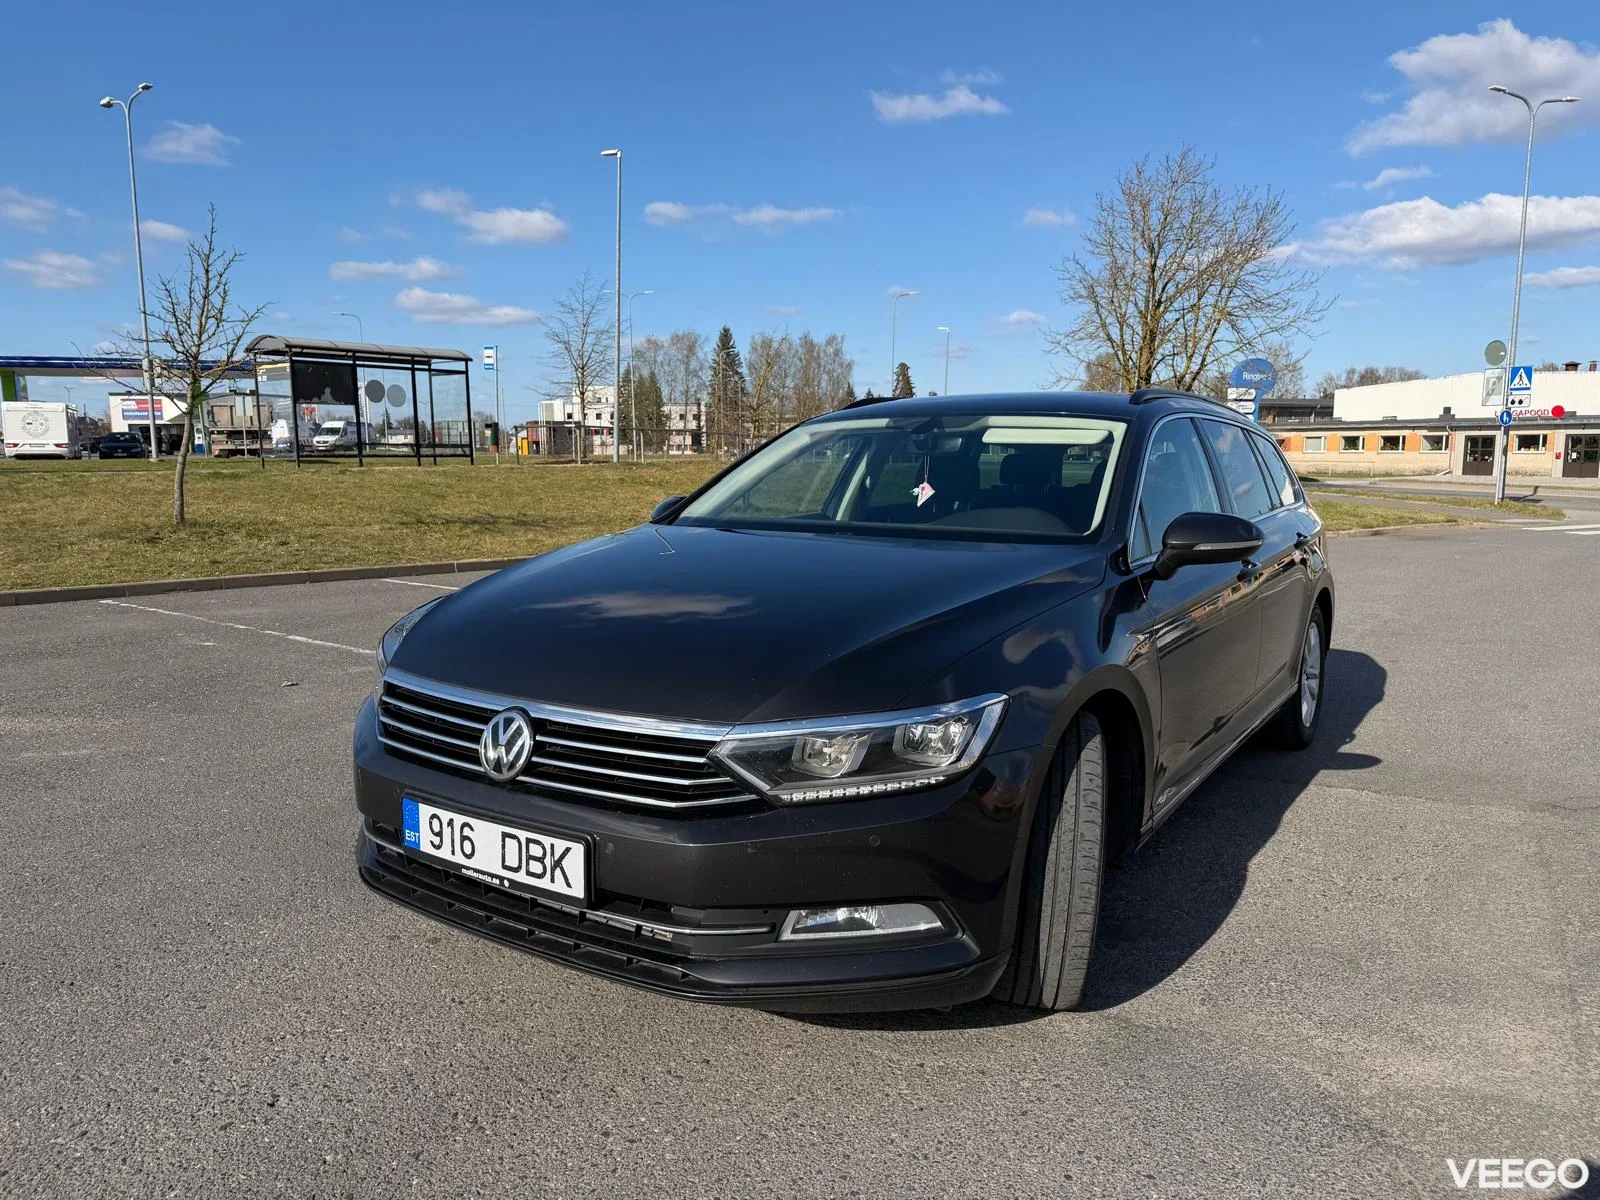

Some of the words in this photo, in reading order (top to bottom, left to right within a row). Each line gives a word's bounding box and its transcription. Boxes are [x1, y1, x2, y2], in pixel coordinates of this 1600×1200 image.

[1495, 409, 1549, 417] LGAPOOD
[405, 830, 420, 843] EST
[428, 812, 476, 860] 916
[500, 830, 573, 889] DBK
